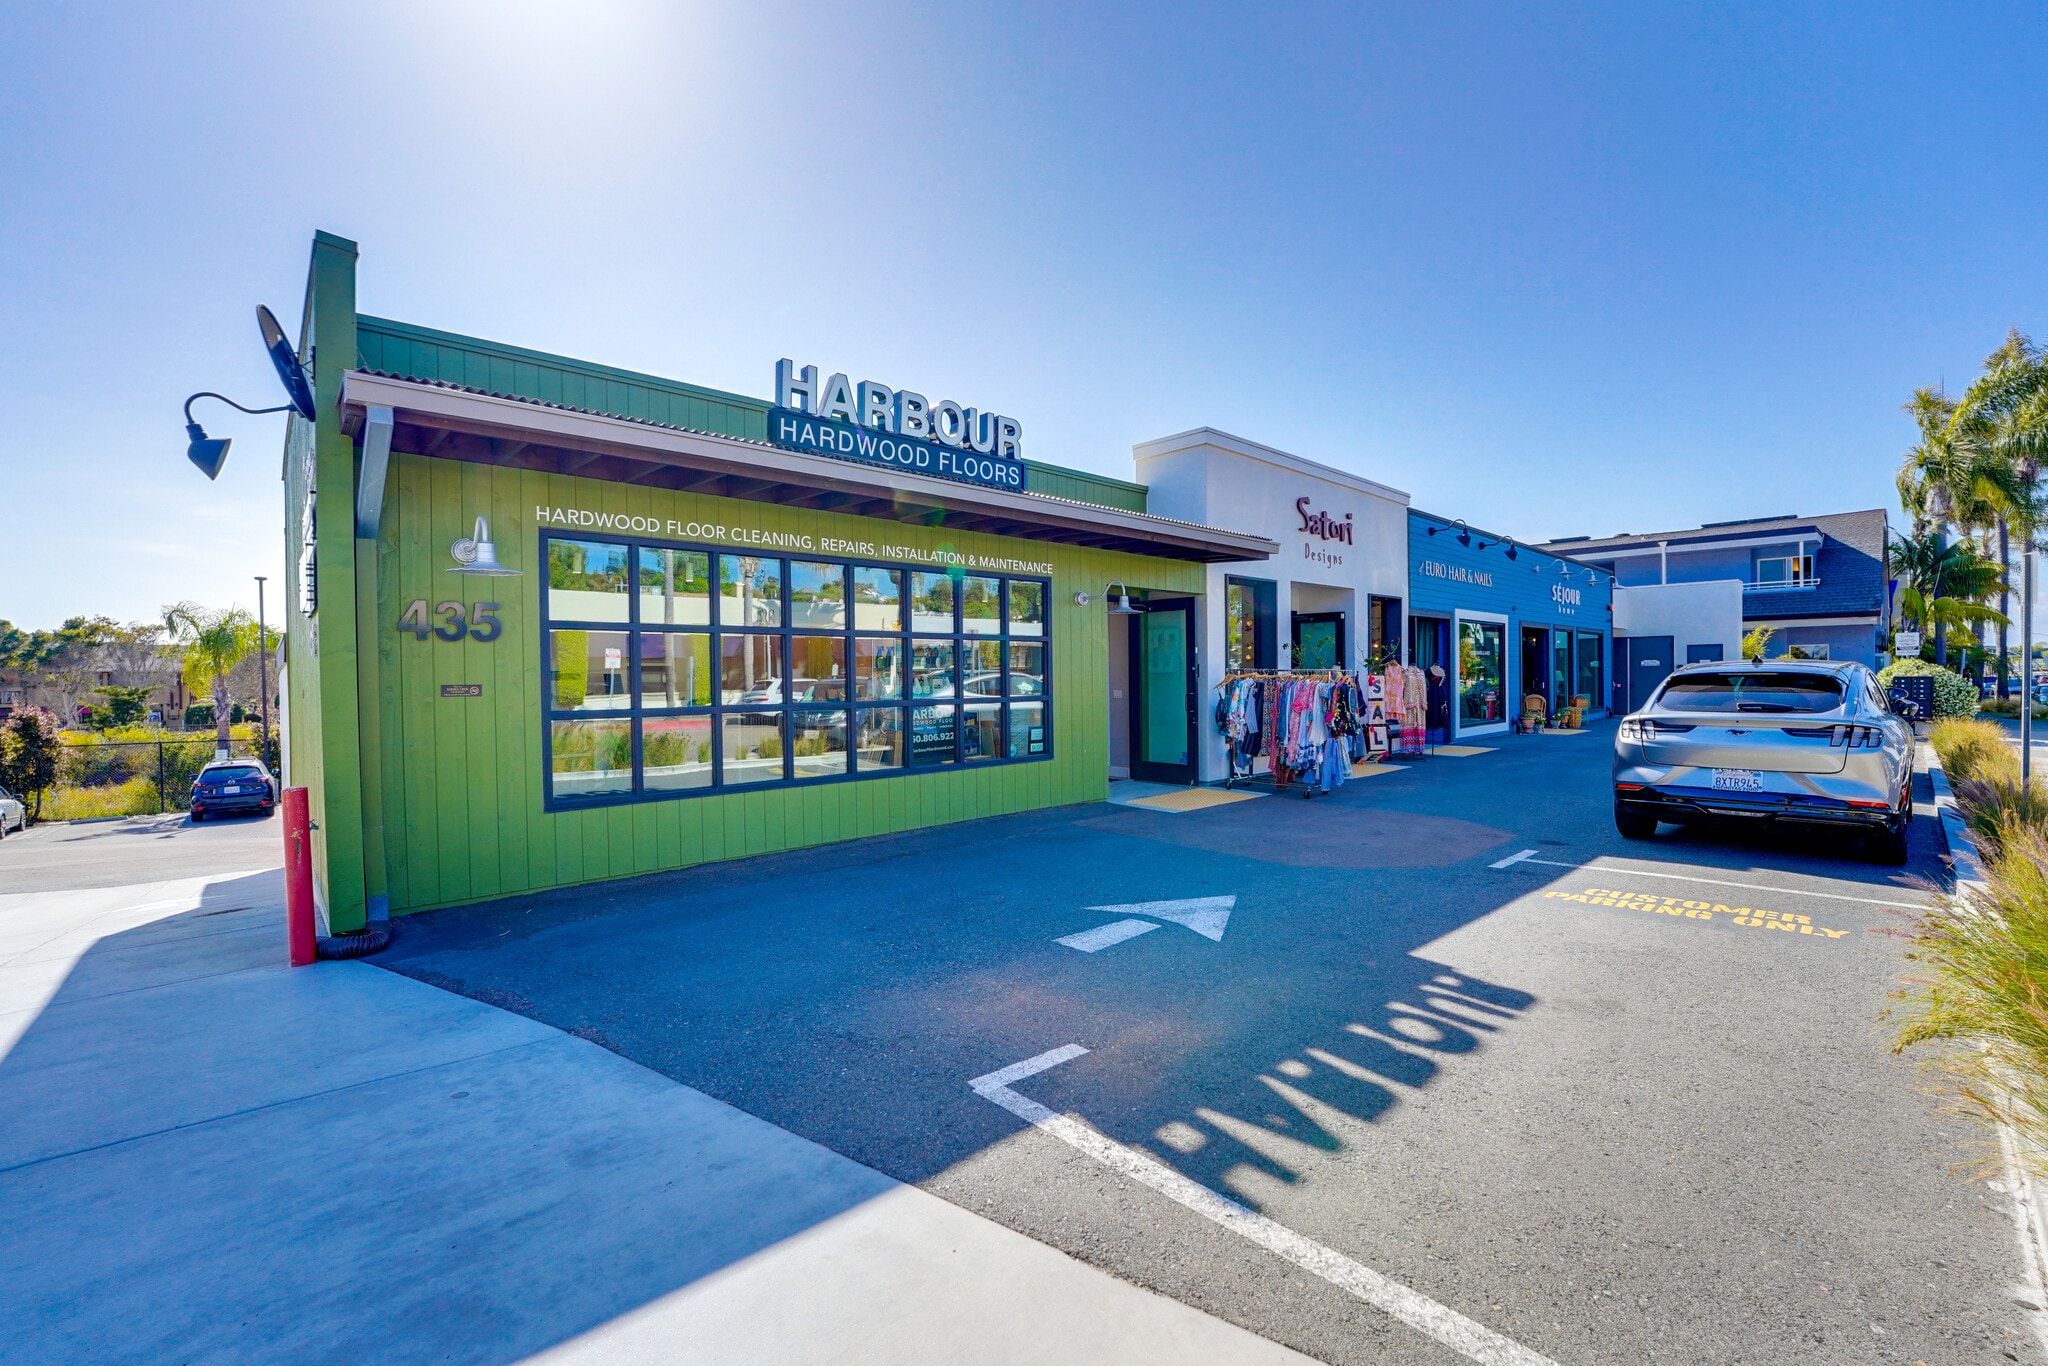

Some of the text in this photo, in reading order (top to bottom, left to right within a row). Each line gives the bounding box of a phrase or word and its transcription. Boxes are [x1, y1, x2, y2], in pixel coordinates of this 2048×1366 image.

[775, 358, 1022, 460] HARBOUR
[780, 417, 1020, 485] HARDWOOD FLOORS
[535, 505, 1053, 574] HARDWOOD FLOOR CLEANING, REPAIRS, INSTALLATION & MAINTENANCE
[1296, 496, 1353, 545] Satori
[1304, 542, 1343, 569] Designs
[1425, 560, 1493, 587] EURO HAIR & NAILS
[1551, 582, 1581, 606] SÉJOUR
[397, 598, 502, 642] 435
[1715, 776, 1759, 788] 8XTR945
[1542, 890, 1851, 939] PARKING ONLY
[1583, 887, 1812, 924] CUSTOMER
